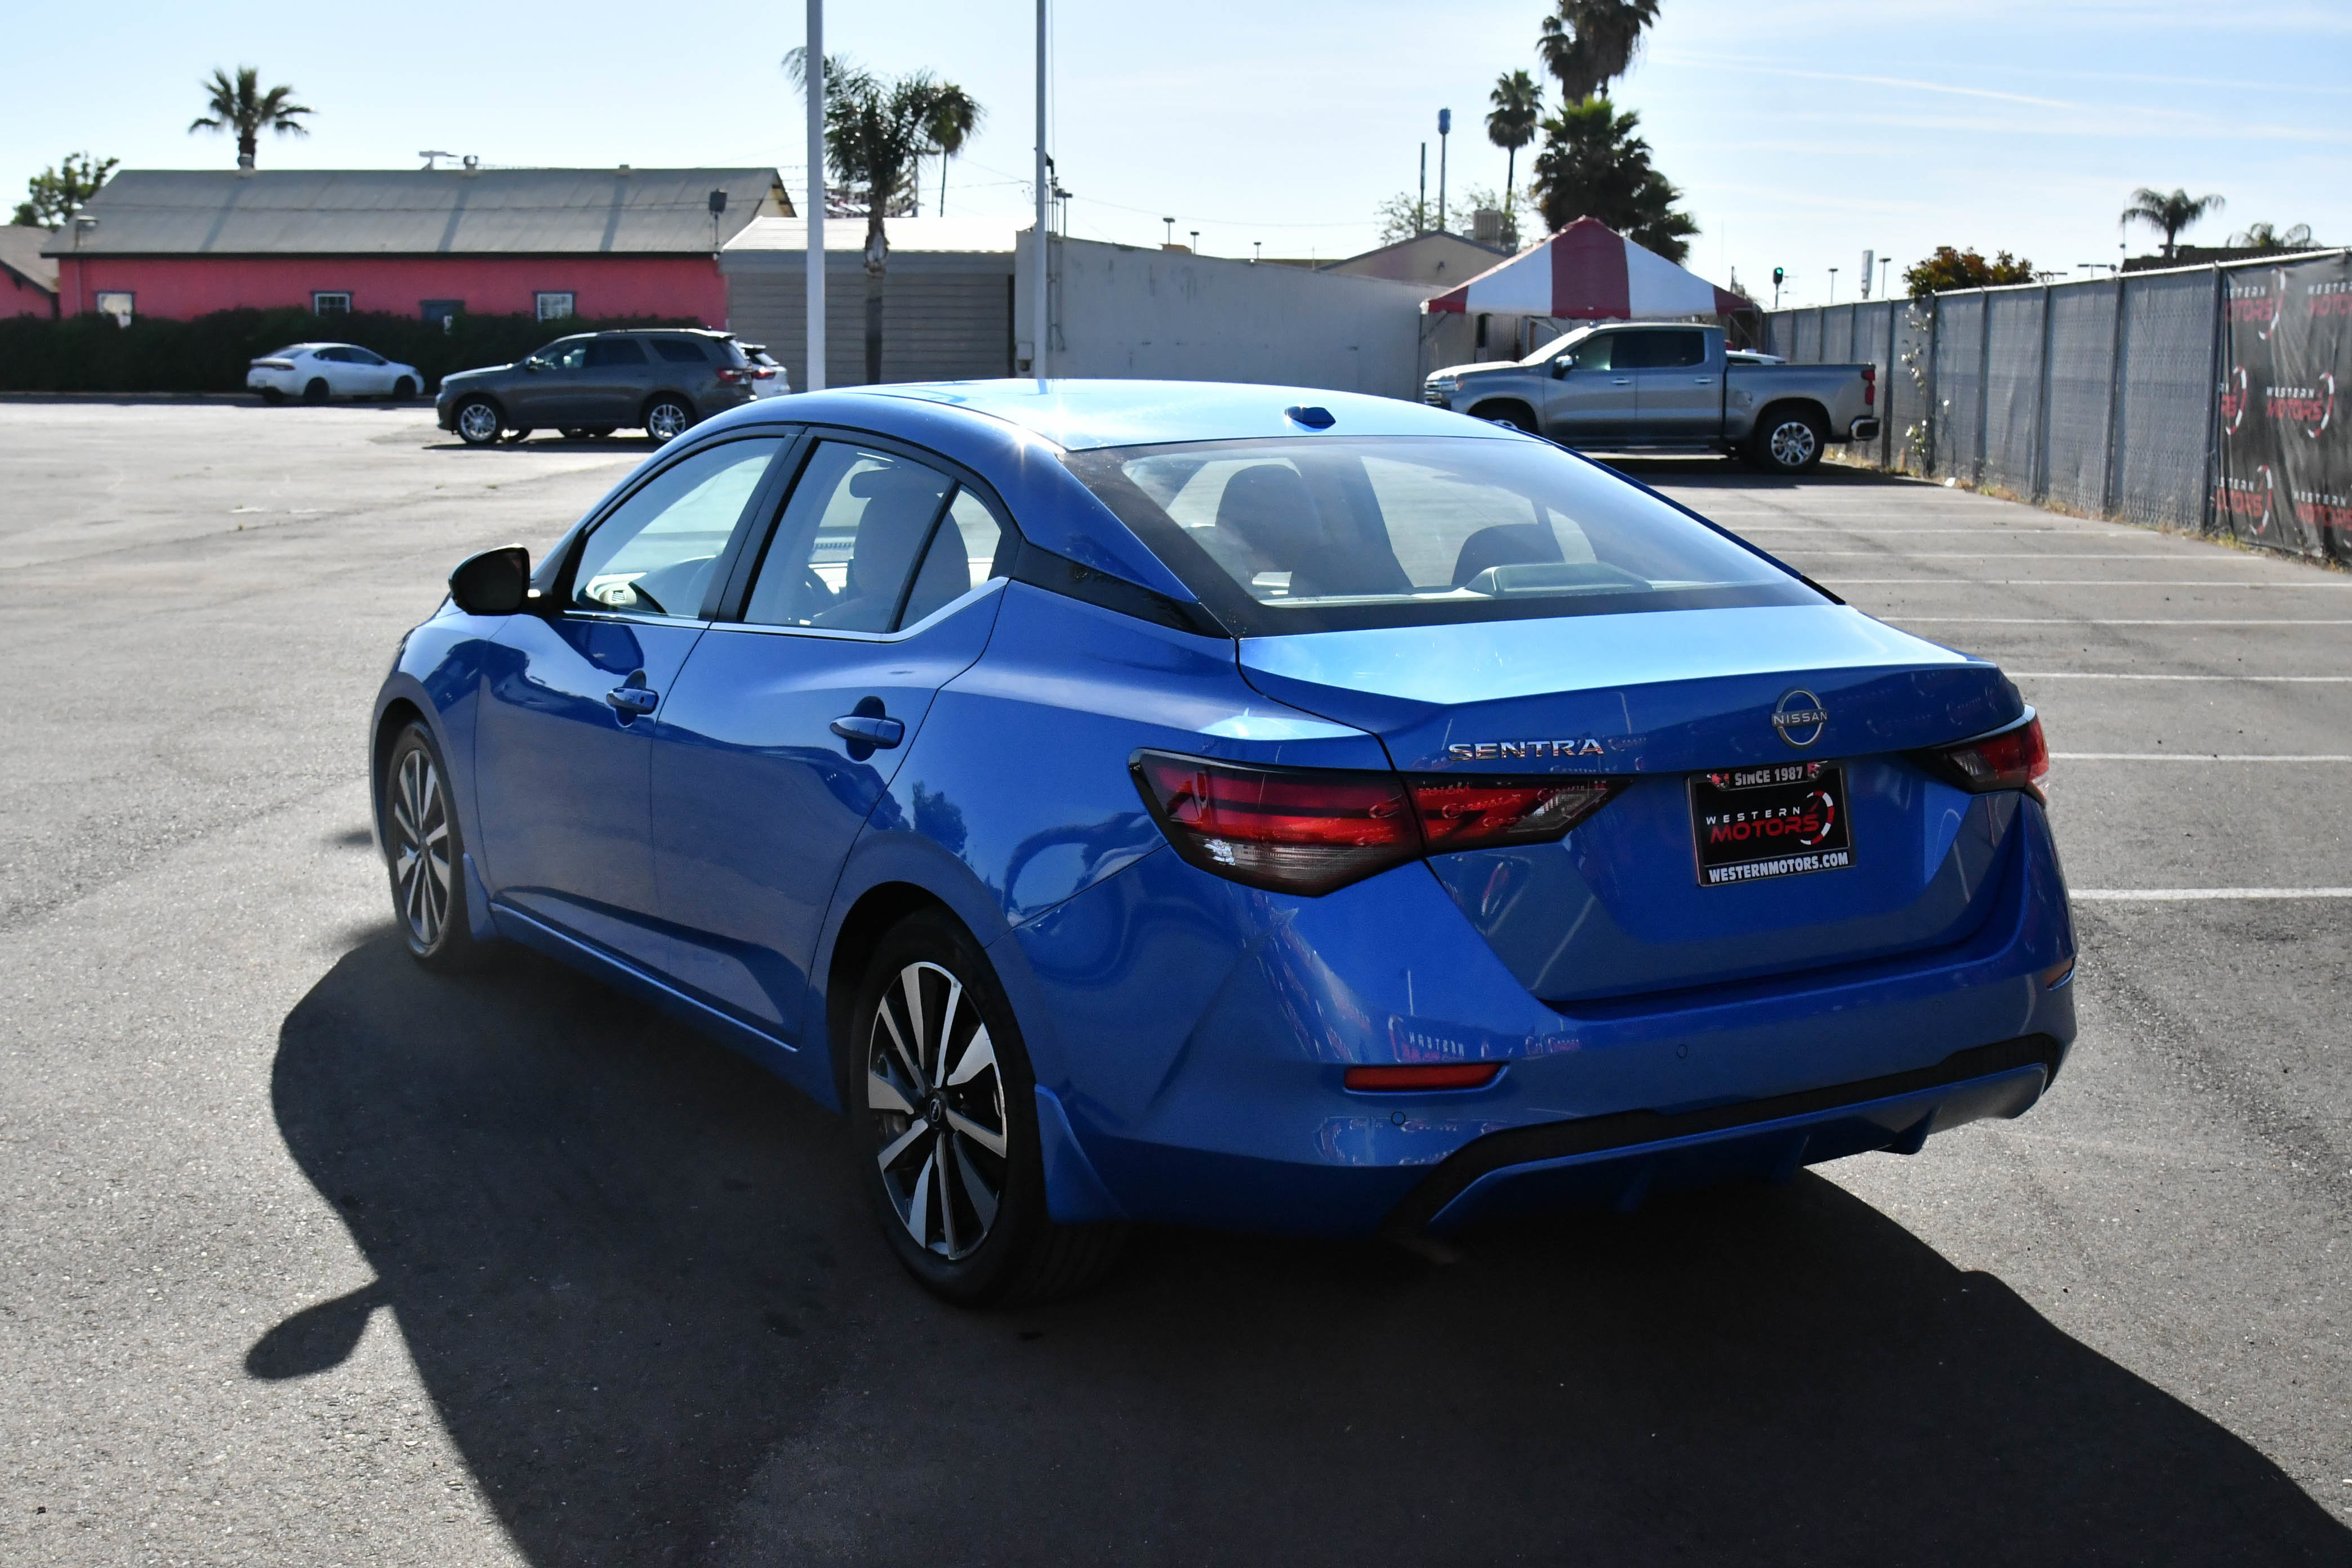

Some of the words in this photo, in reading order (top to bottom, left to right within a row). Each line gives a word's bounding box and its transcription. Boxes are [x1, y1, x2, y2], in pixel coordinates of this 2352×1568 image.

[2266, 386, 2315, 398] WESTERN
[2266, 397, 2323, 421] MOTORS
[2293, 491, 2347, 507] WESTERN
[1774, 711, 1827, 725] NISSAN
[1448, 738, 1604, 760] SENTRA
[1735, 770, 1771, 786] SINCE
[1775, 766, 1803, 782] 1987
[1706, 807, 1801, 825] WESTERN
[1710, 813, 1820, 843] MOTORS
[1709, 852, 1848, 883] WESTERNMOTORS.COM
